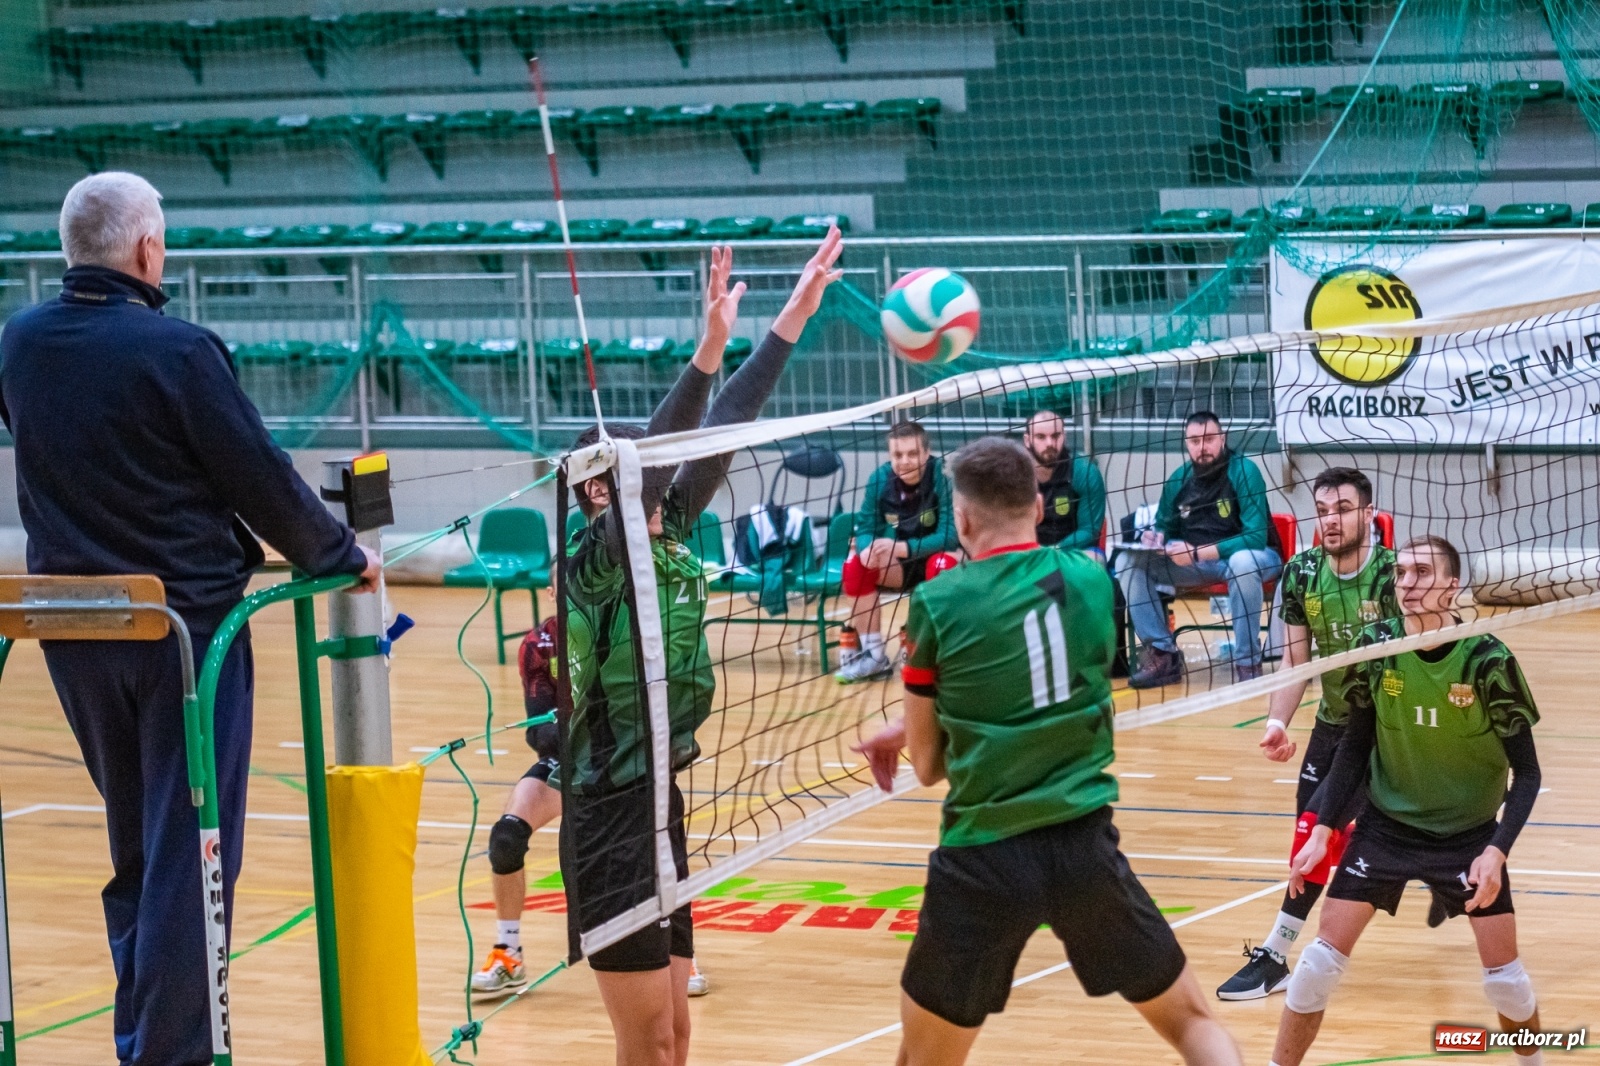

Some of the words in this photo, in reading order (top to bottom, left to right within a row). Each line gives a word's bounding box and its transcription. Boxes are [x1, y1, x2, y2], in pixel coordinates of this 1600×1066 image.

[1450, 355, 1531, 409] JEST
[1541, 341, 1575, 376] W
[1329, 622, 1355, 641] 15
[1024, 603, 1070, 709] 11
[1413, 705, 1440, 728] 11
